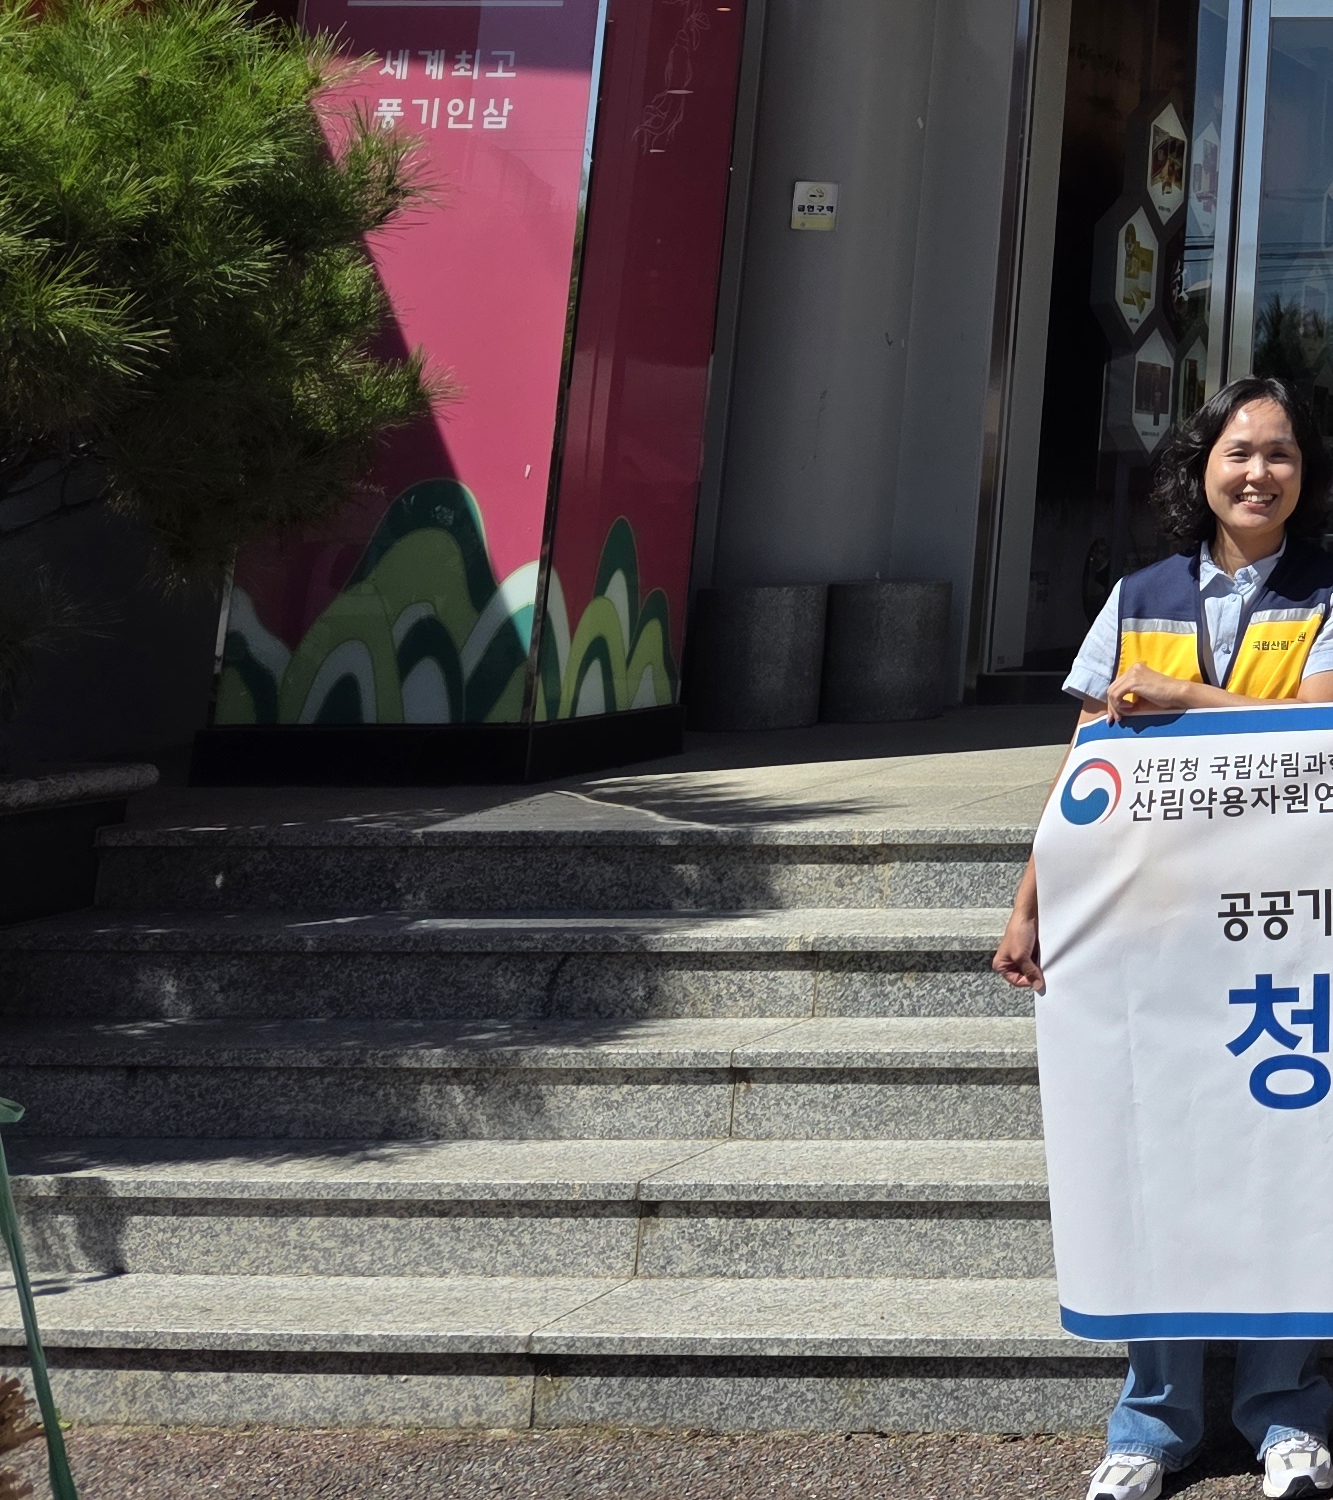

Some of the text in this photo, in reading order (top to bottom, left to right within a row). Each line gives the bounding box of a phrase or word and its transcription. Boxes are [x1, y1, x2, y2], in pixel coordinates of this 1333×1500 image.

[378, 49, 517, 80] 세계최고
[374, 97, 513, 129] 풍기인삼
[1132, 756, 1200, 784] 산림청
